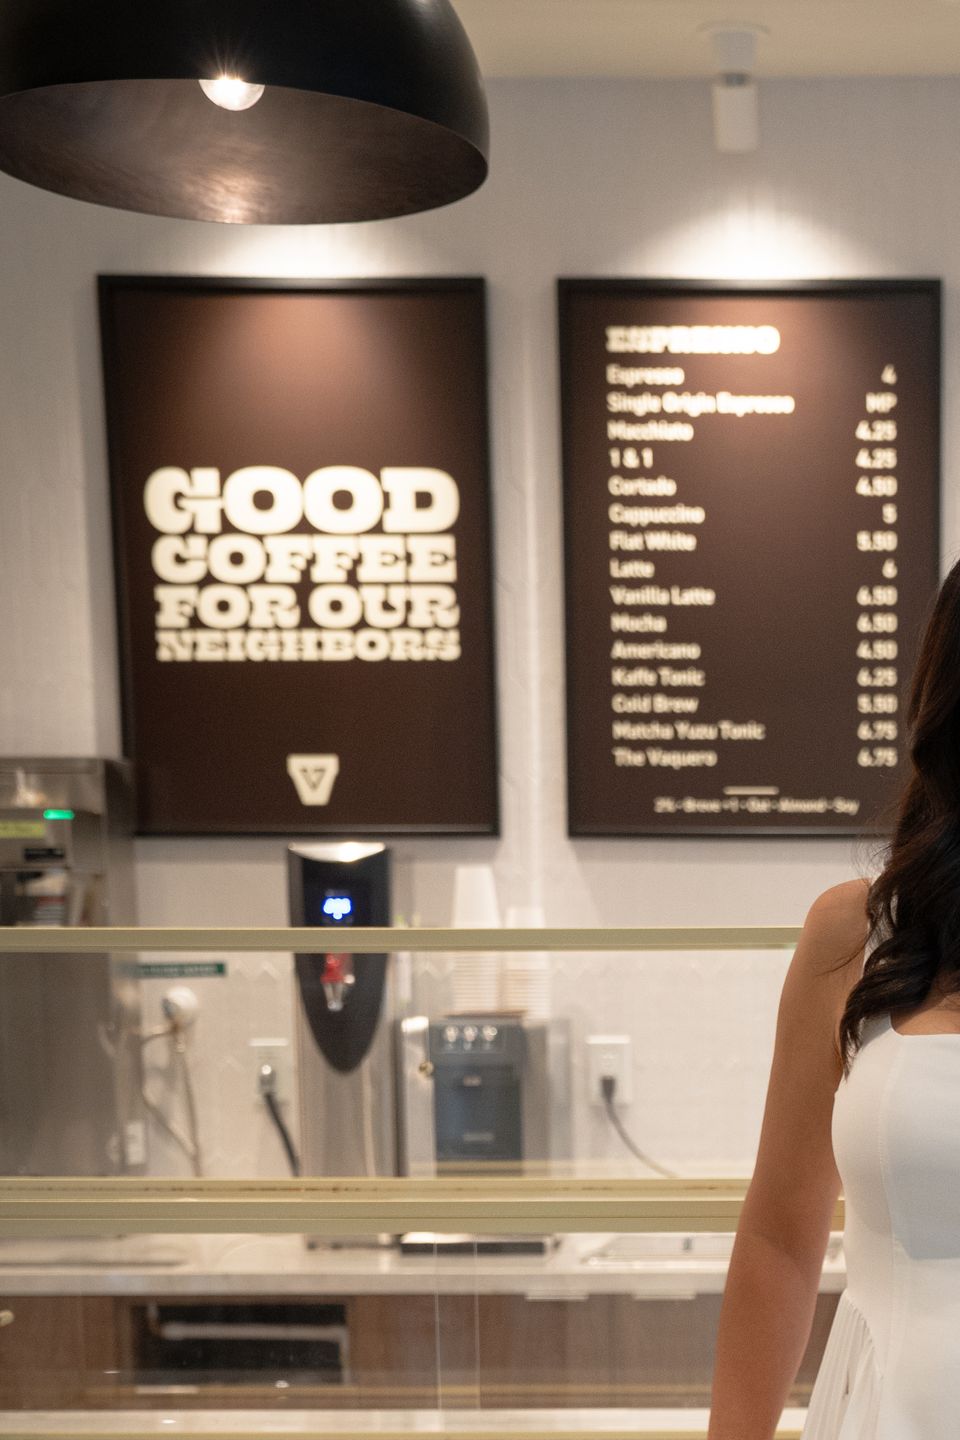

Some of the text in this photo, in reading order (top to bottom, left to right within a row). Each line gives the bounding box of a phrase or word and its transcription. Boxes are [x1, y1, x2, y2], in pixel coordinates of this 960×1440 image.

[881, 365, 896, 384] 4
[610, 447, 653, 468] 1 & 1
[145, 465, 459, 535] GOOD
[609, 502, 705, 526] Cappuccino
[153, 534, 456, 584] COFFEE
[610, 559, 654, 578] Latte
[882, 559, 897, 578] 6
[610, 585, 715, 605] Vanilla Latte
[857, 585, 897, 605] 6.50
[155, 583, 459, 629] FOR OUR
[857, 612, 897, 632] 6.50
[157, 628, 460, 661] NEIGHBORS
[612, 641, 701, 659] Americano
[857, 639, 897, 659] 4.50
[658, 666, 704, 686] Tonic
[857, 666, 897, 686] 6.25
[612, 693, 698, 713] Cold Brew
[613, 720, 764, 739] Matcha Yuzu Tonic
[858, 720, 897, 740] 6.75
[613, 746, 645, 766] The
[858, 747, 897, 766] 6.75
